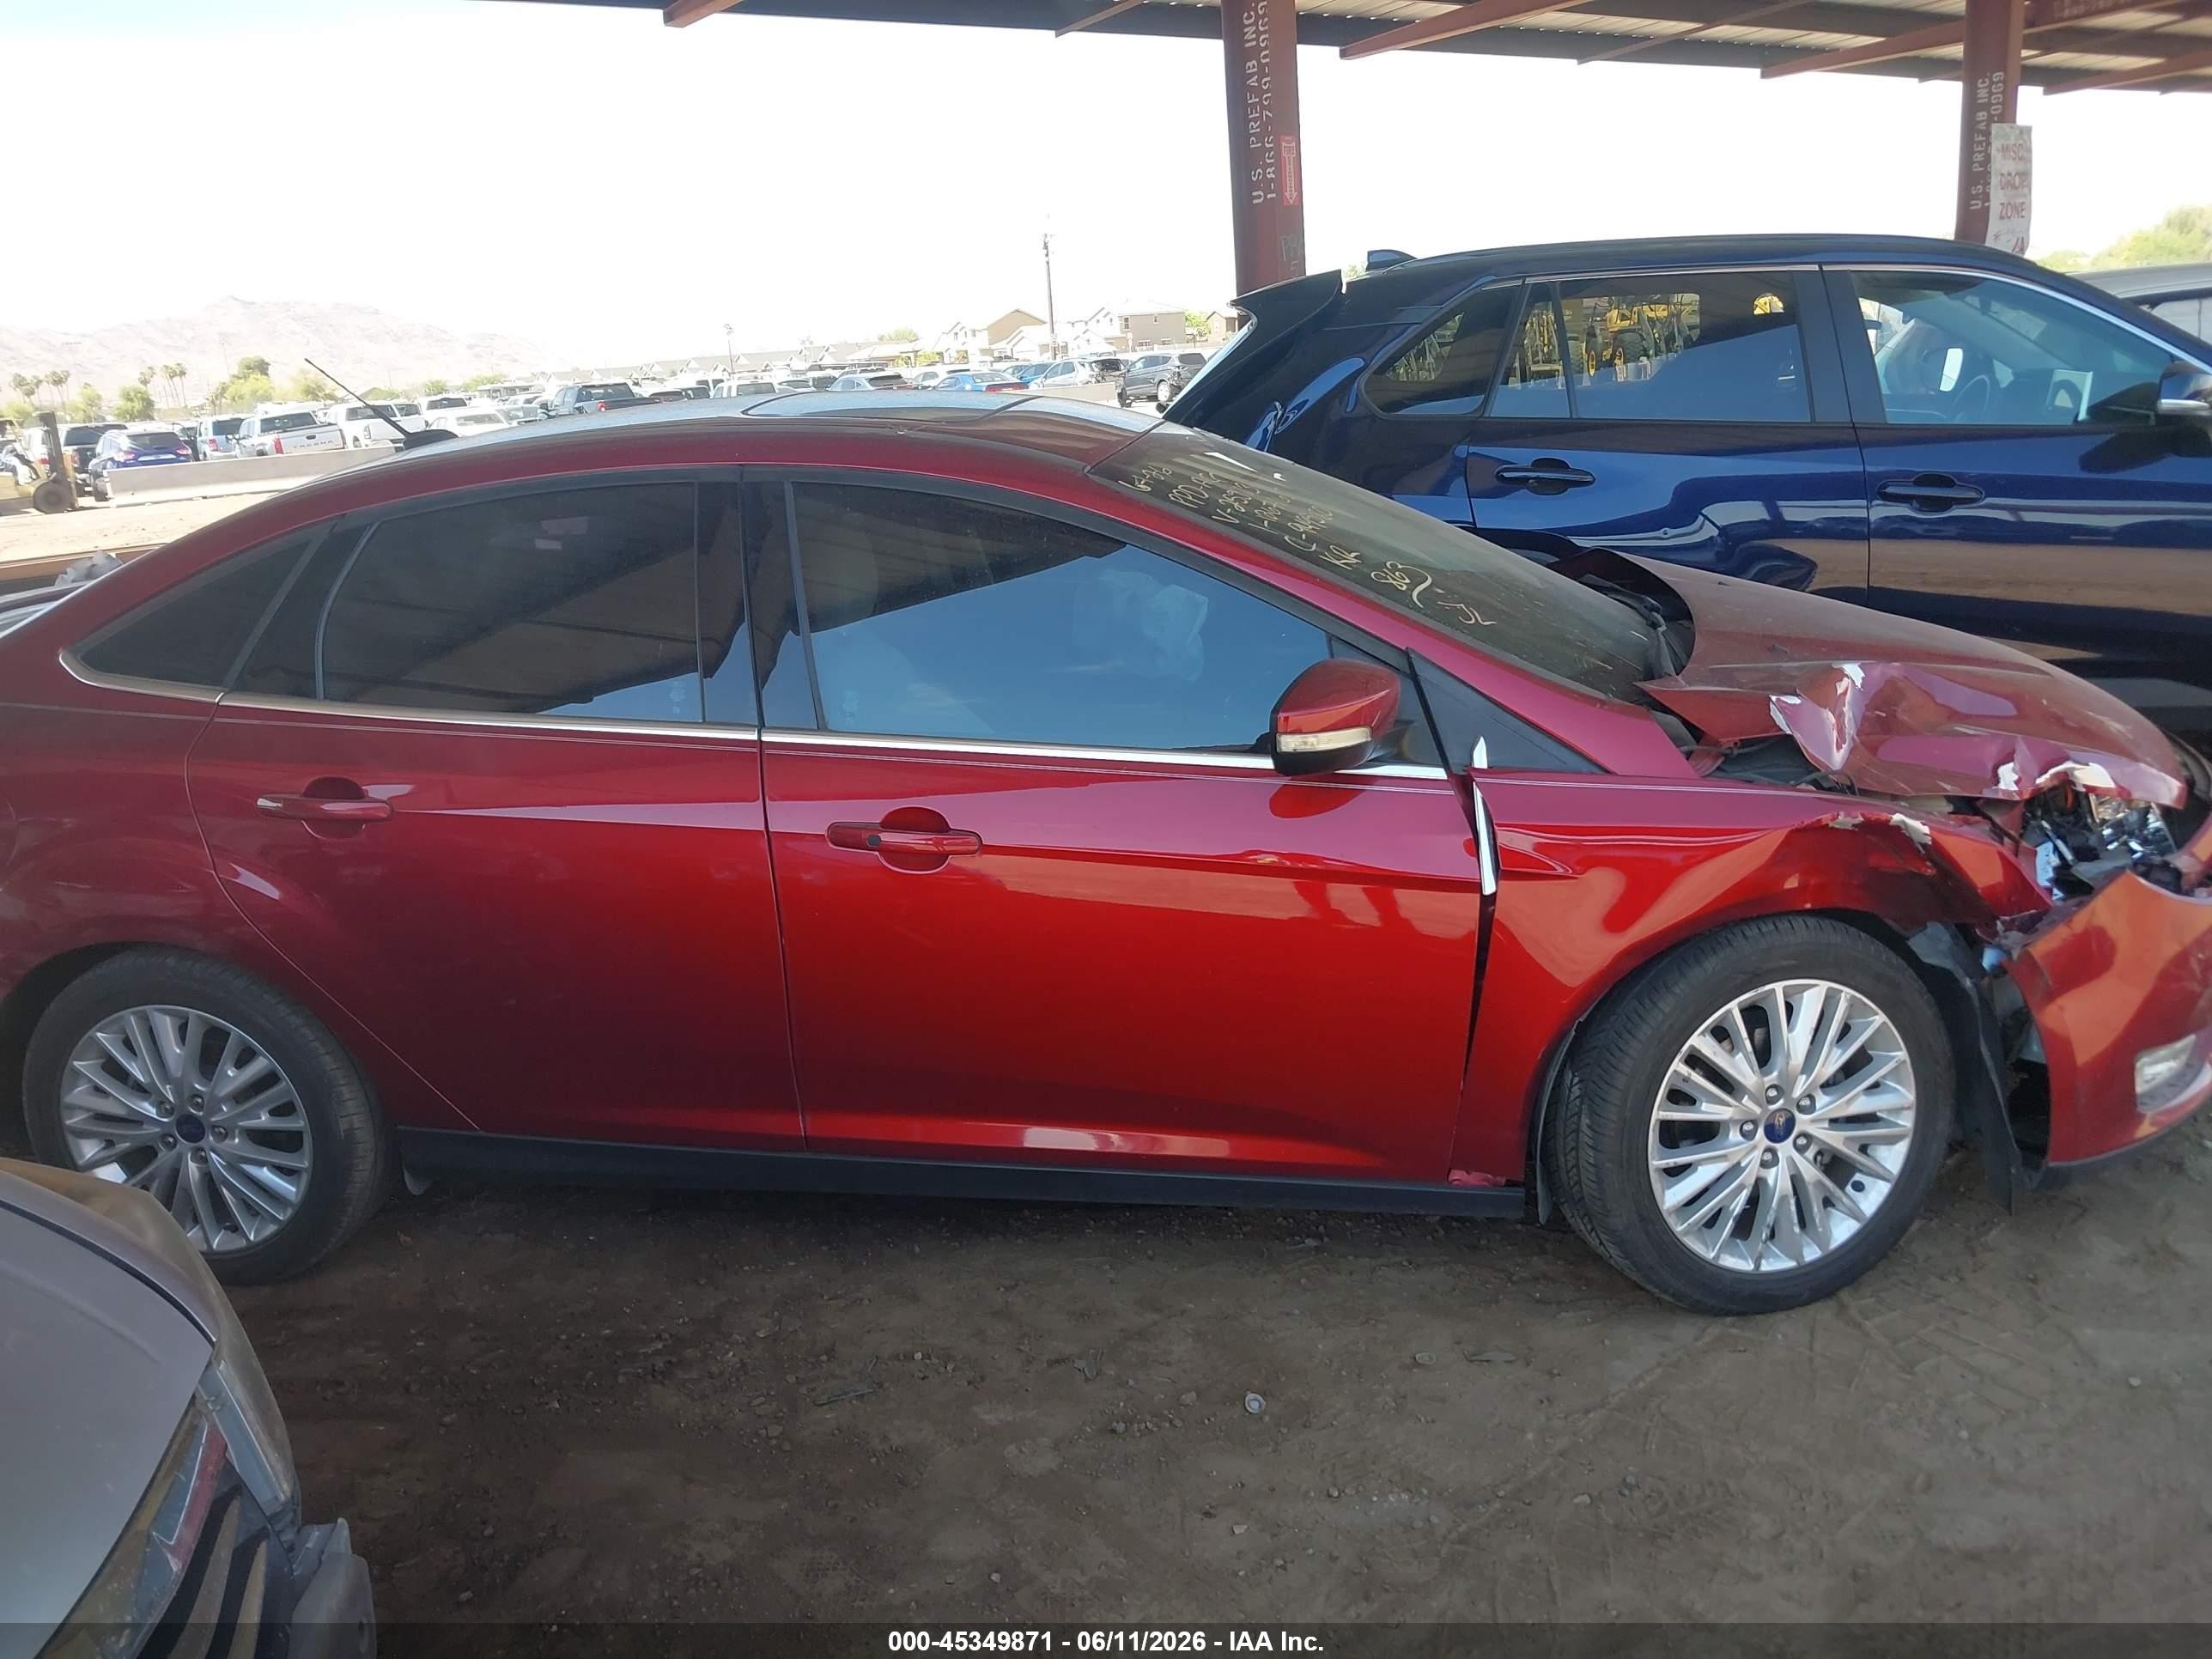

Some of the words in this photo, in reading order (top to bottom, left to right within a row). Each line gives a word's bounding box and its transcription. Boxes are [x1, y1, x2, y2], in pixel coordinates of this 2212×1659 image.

[1243, 2, 1256, 48] INC.
[1245, 59, 1261, 149] PREFAB
[1977, 71, 1990, 103] INC.
[1972, 110, 1988, 172] PREFAB
[1251, 161, 1265, 204] U.S.
[1970, 179, 1984, 210] U.S.
[1999, 172, 2027, 191] DROP
[1999, 201, 2027, 220] ZONE
